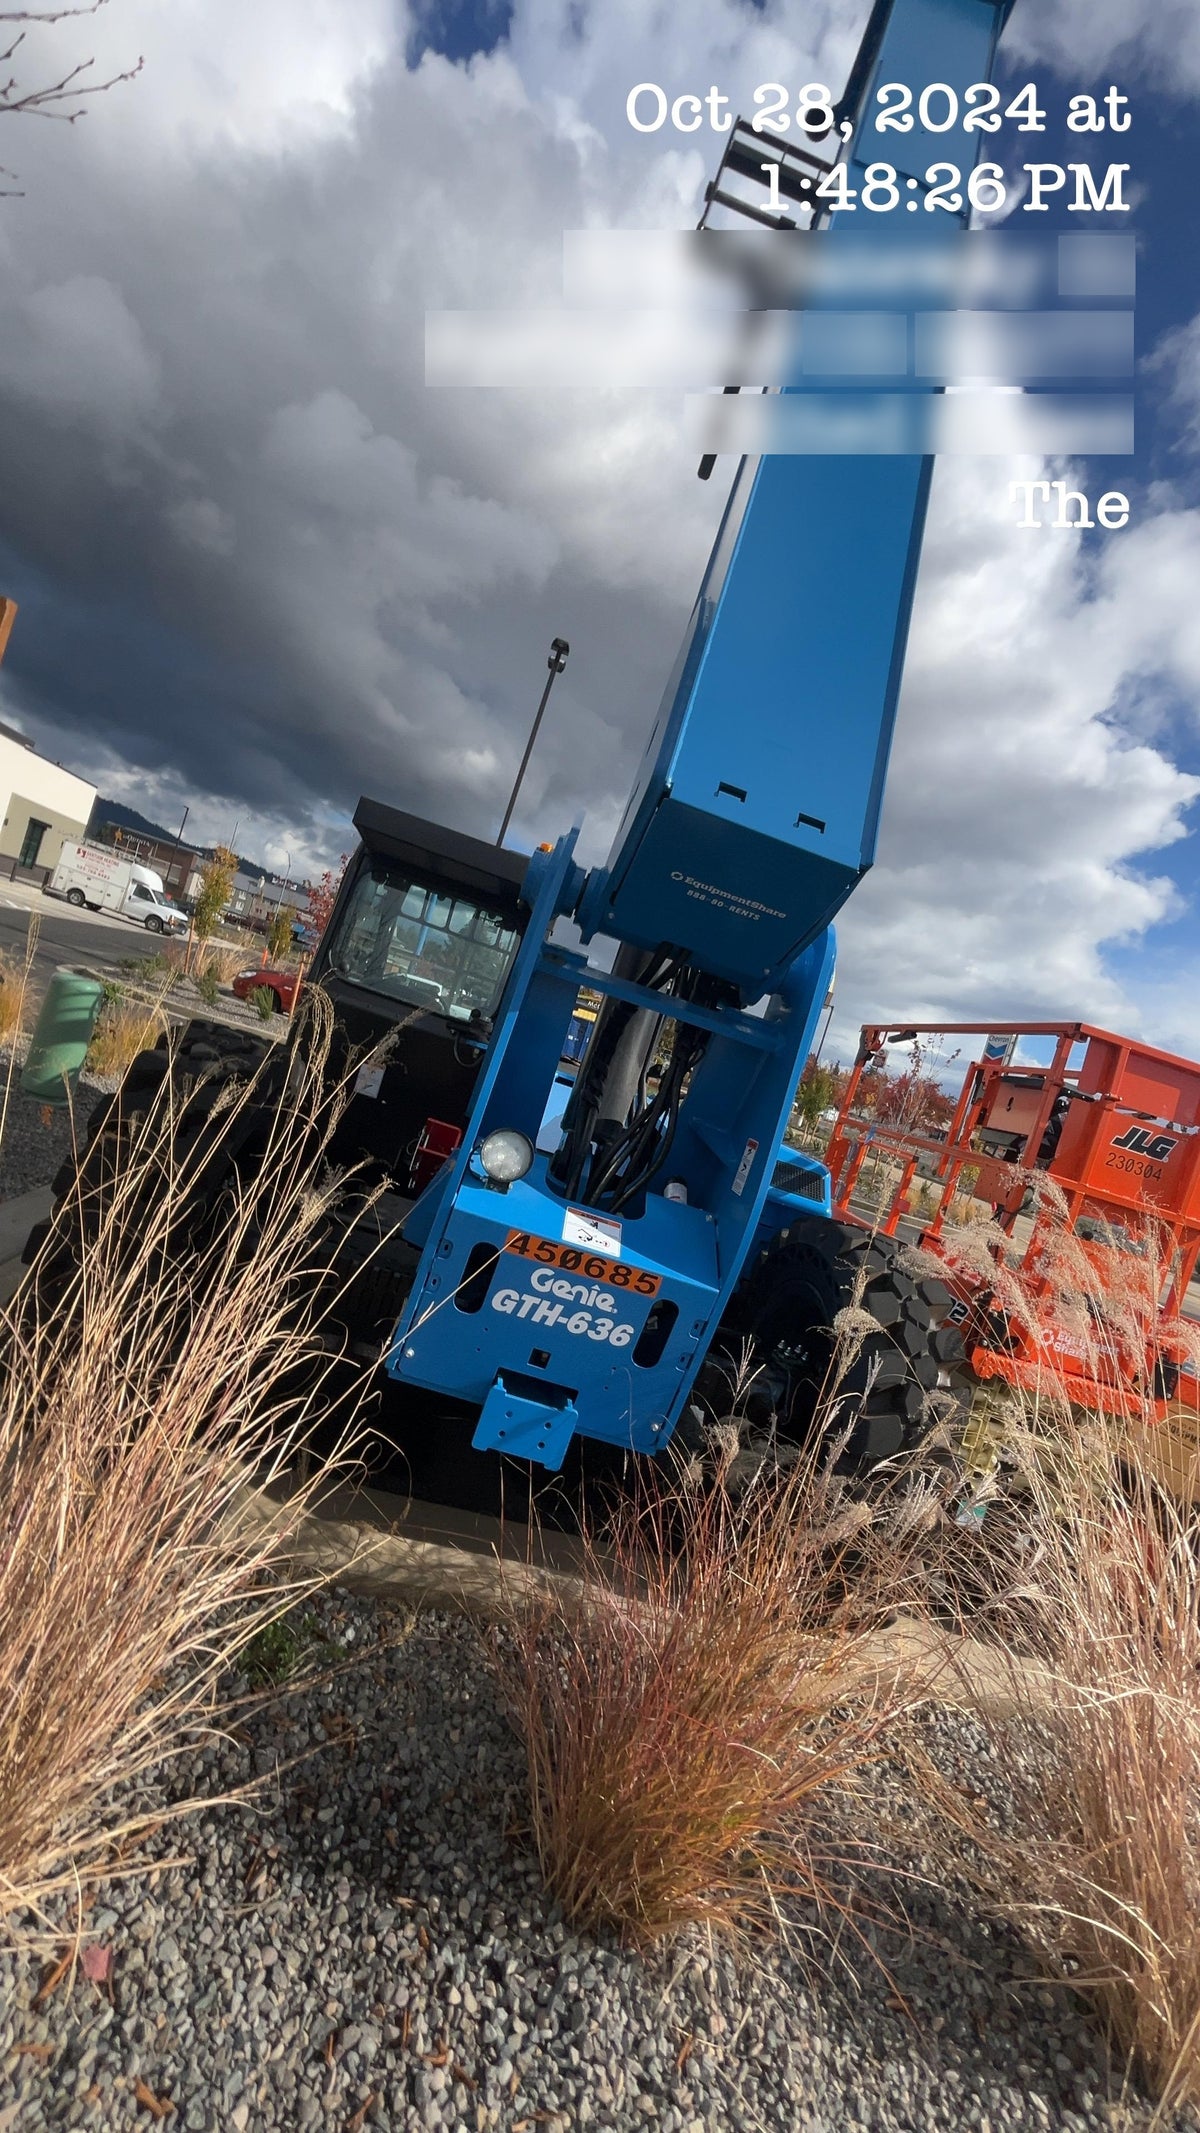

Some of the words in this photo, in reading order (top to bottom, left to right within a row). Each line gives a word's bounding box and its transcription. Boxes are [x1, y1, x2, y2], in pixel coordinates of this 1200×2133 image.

[684, 876, 787, 919] EquipmentShare
[686, 889, 761, 921] 888-80-RENTS
[1110, 1125, 1179, 1162] JLG
[1105, 1152, 1163, 1182] 230304
[508, 1233, 659, 1294] 450685
[530, 1267, 616, 1313] Genie
[491, 1288, 635, 1347] GTH-636
